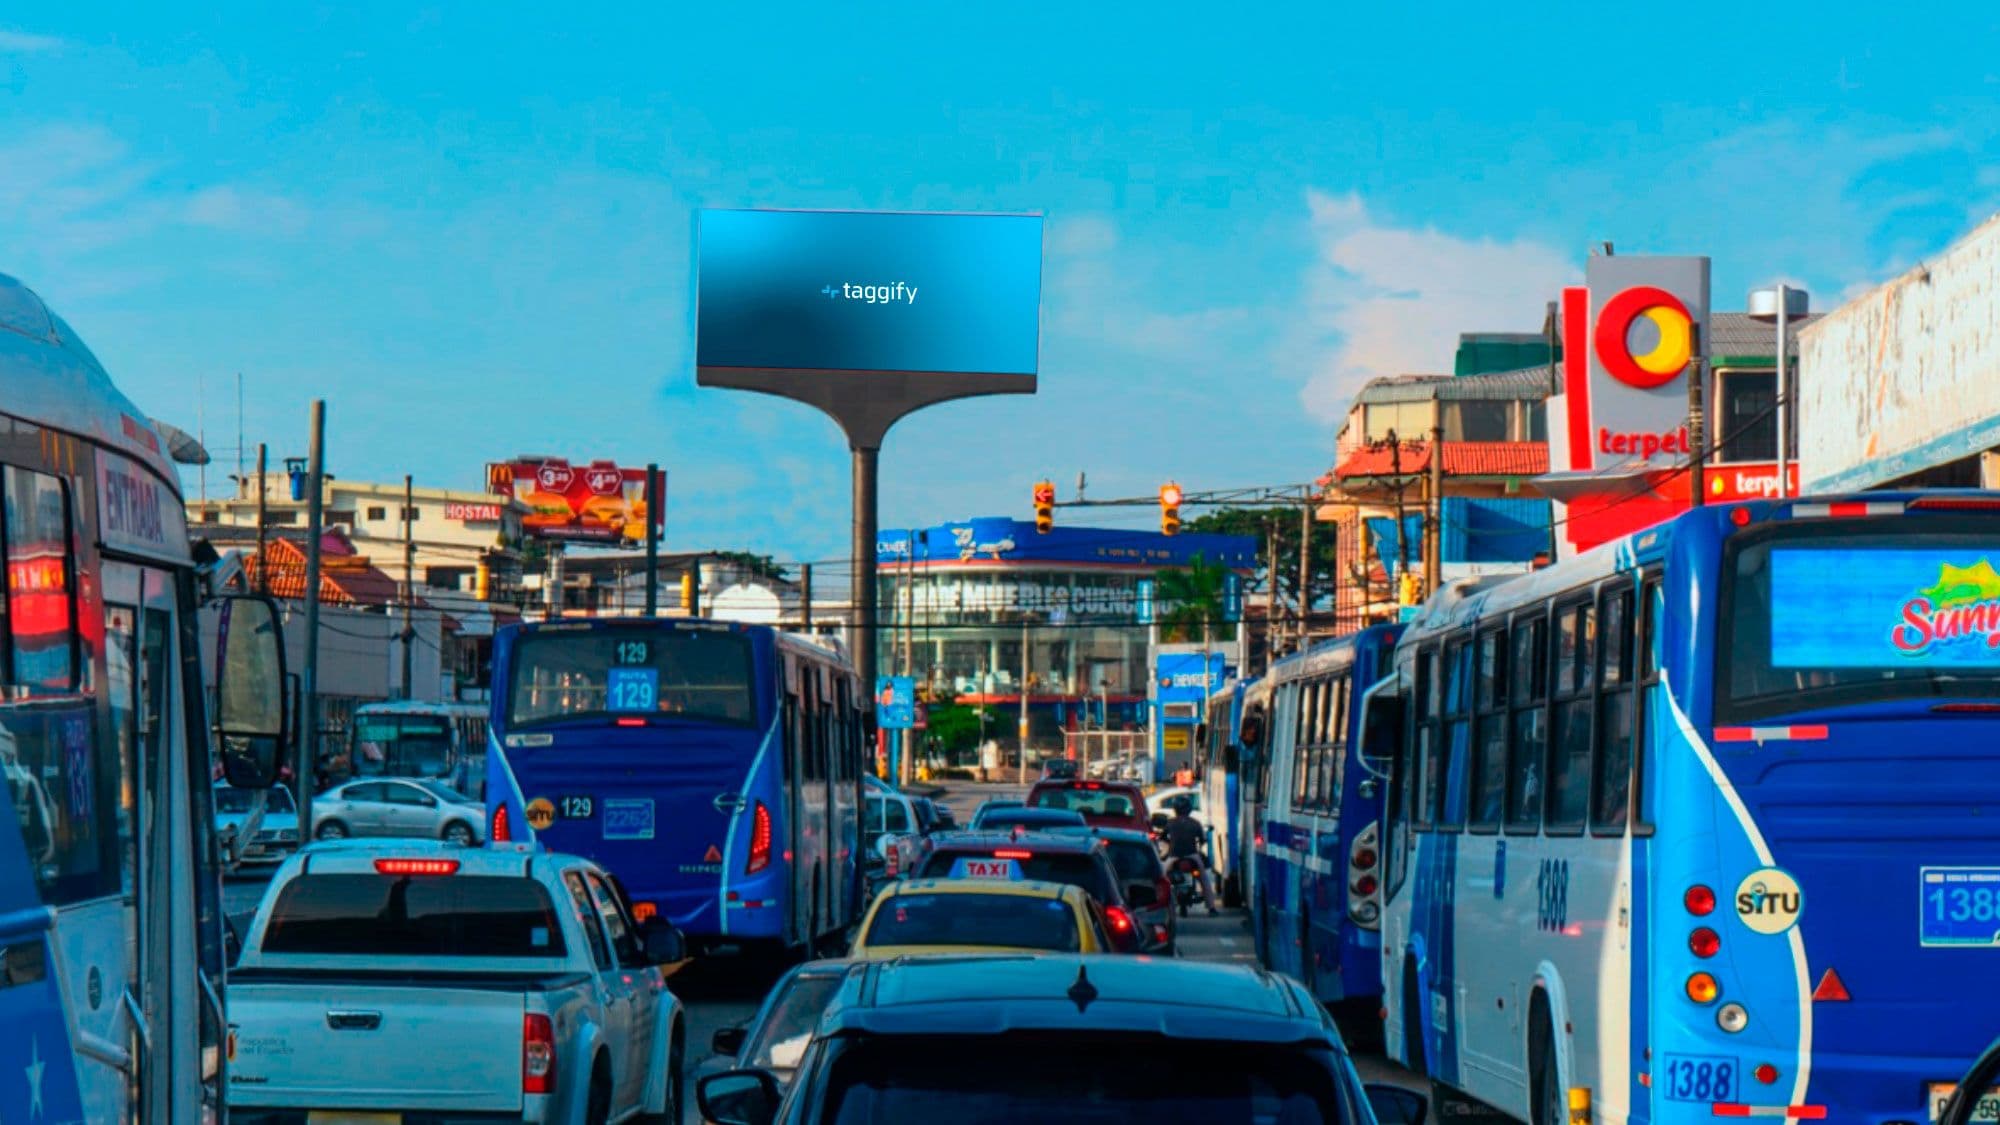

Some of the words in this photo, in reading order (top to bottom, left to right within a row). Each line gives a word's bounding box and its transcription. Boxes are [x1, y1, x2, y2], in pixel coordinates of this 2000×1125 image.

[843, 282, 918, 304] taggify
[1599, 427, 1693, 460] terpel
[1736, 473, 1793, 497] terpl
[106, 470, 164, 543] ENTRADA
[446, 504, 499, 519] HOSTAL
[1892, 598, 2000, 650] Sunn
[617, 641, 647, 664] 129
[612, 682, 653, 709] 129
[562, 797, 593, 817] 129
[967, 862, 1008, 876] TAXI
[1537, 858, 1569, 934] 1388
[1928, 887, 2000, 922] 138
[1667, 1059, 1733, 1100] 1388
